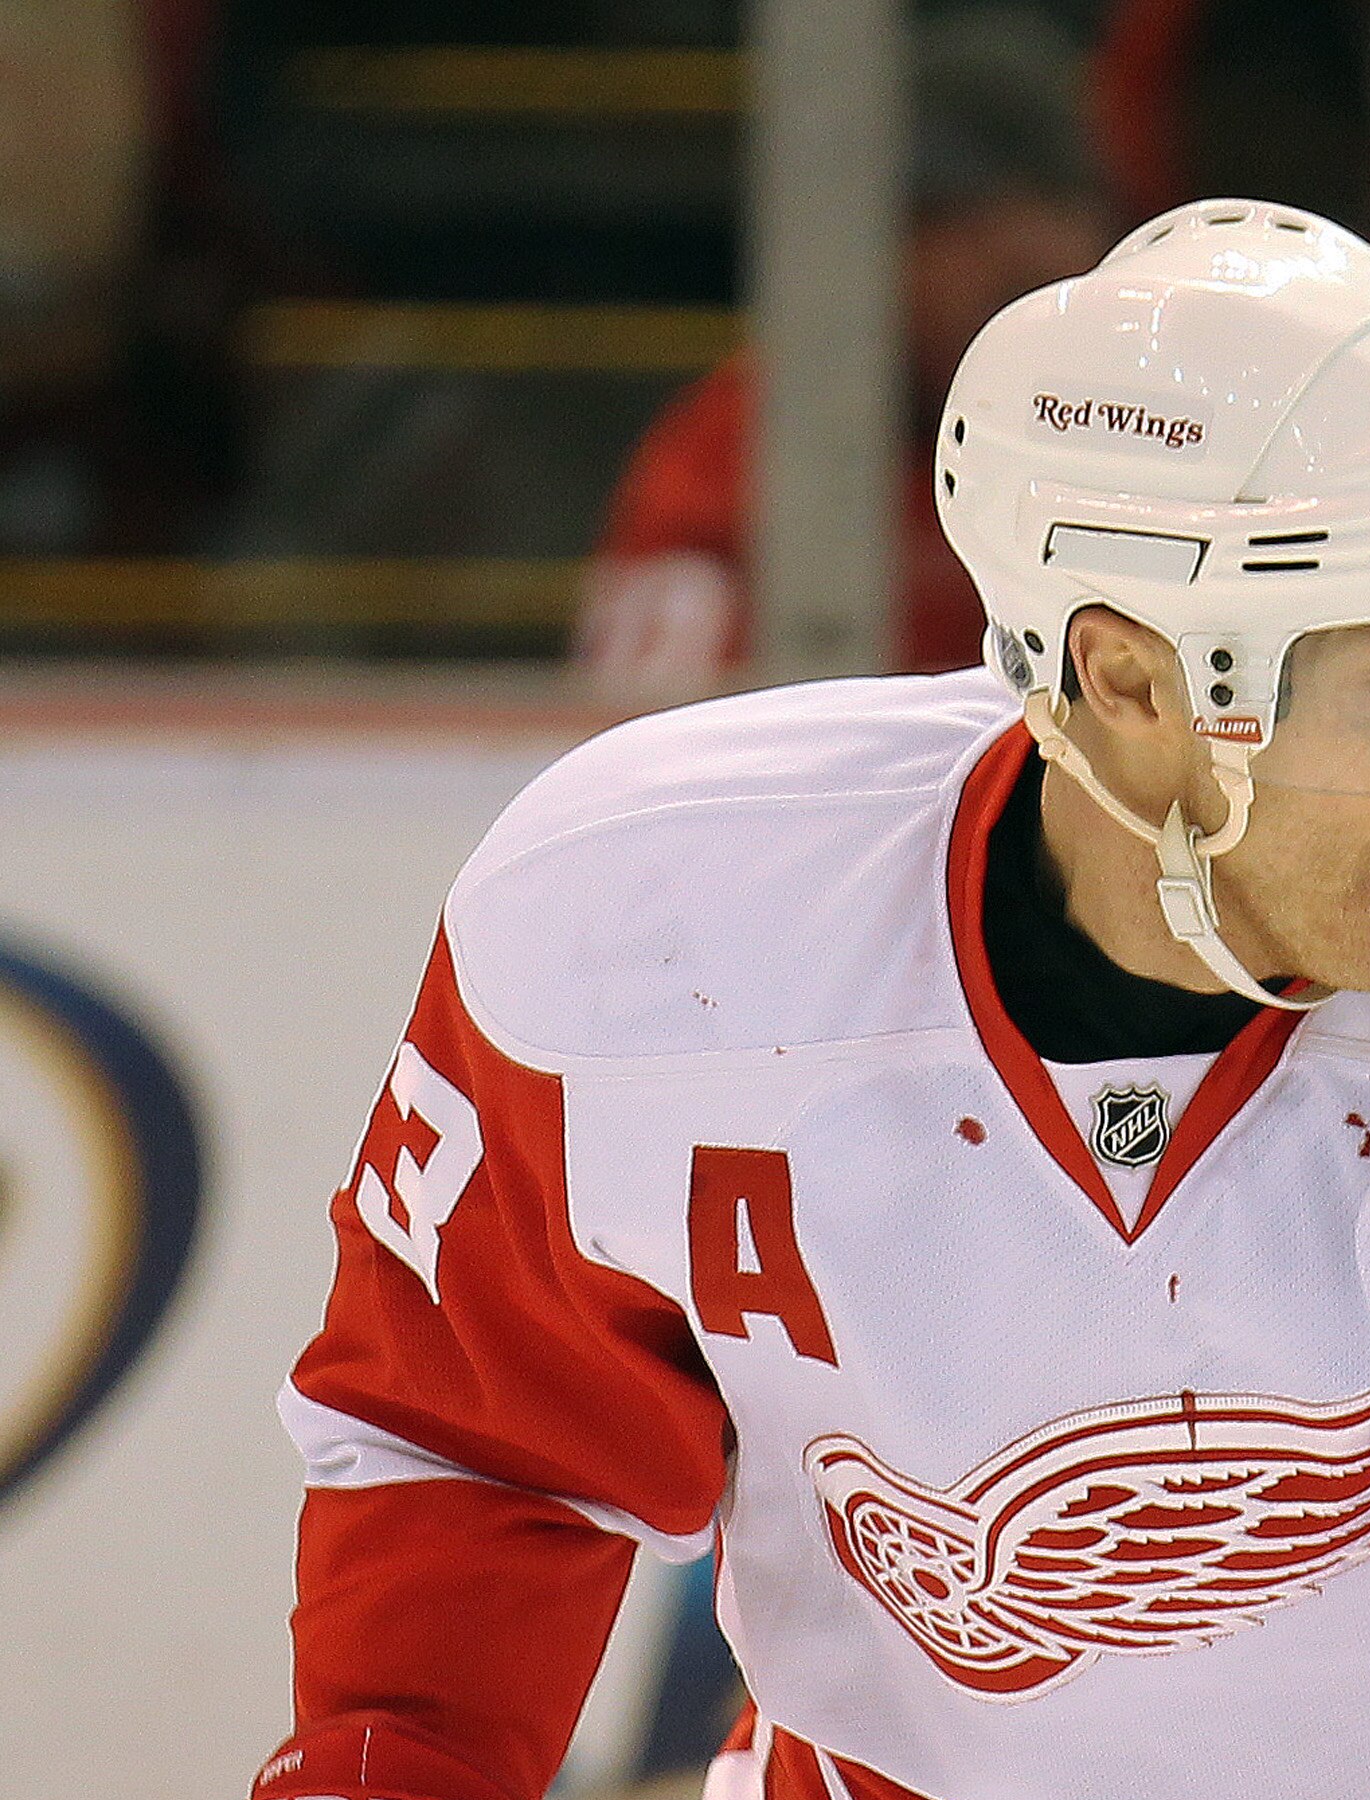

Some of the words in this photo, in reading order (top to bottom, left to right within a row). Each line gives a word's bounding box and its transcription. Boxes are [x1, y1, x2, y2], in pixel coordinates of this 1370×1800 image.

[1034, 393, 1093, 432] Red
[1098, 402, 1204, 448] Wings
[1111, 1105, 1158, 1154] NHL
[687, 1144, 841, 1370] A
